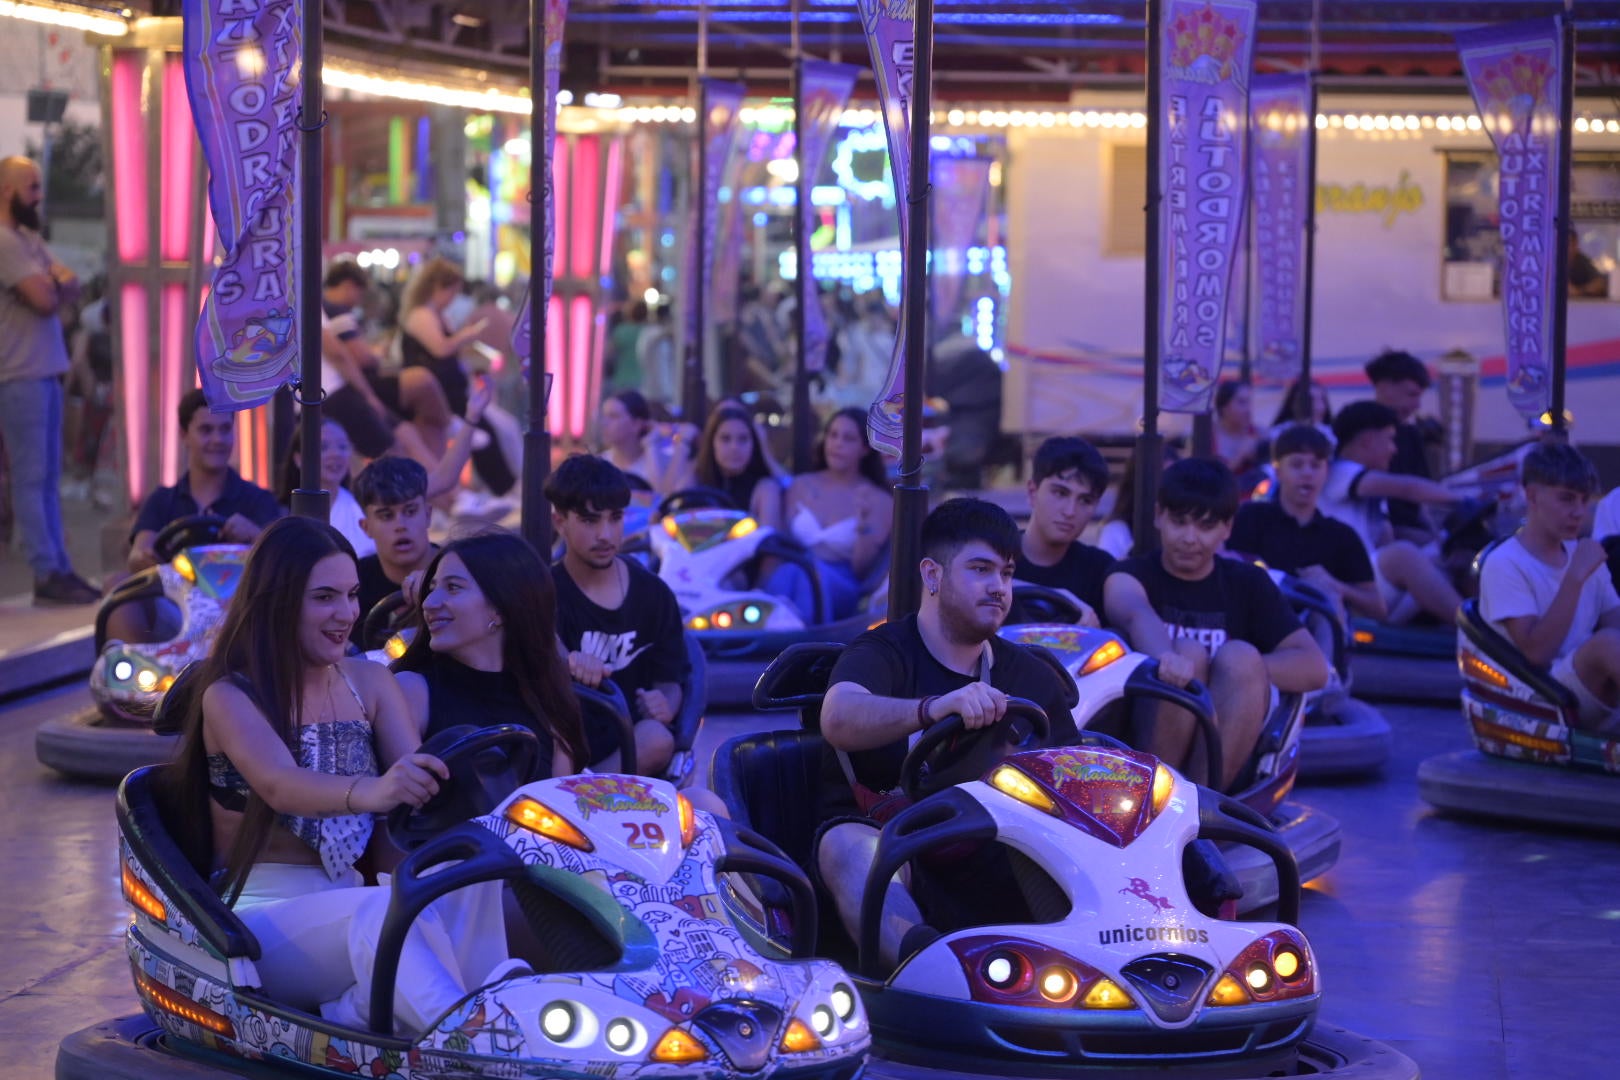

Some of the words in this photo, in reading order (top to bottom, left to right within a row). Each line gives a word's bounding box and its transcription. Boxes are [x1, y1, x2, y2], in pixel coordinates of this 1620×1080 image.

[580, 630, 638, 665] NIKE
[621, 822, 667, 850] 29
[1098, 924, 1209, 945] unicornios
